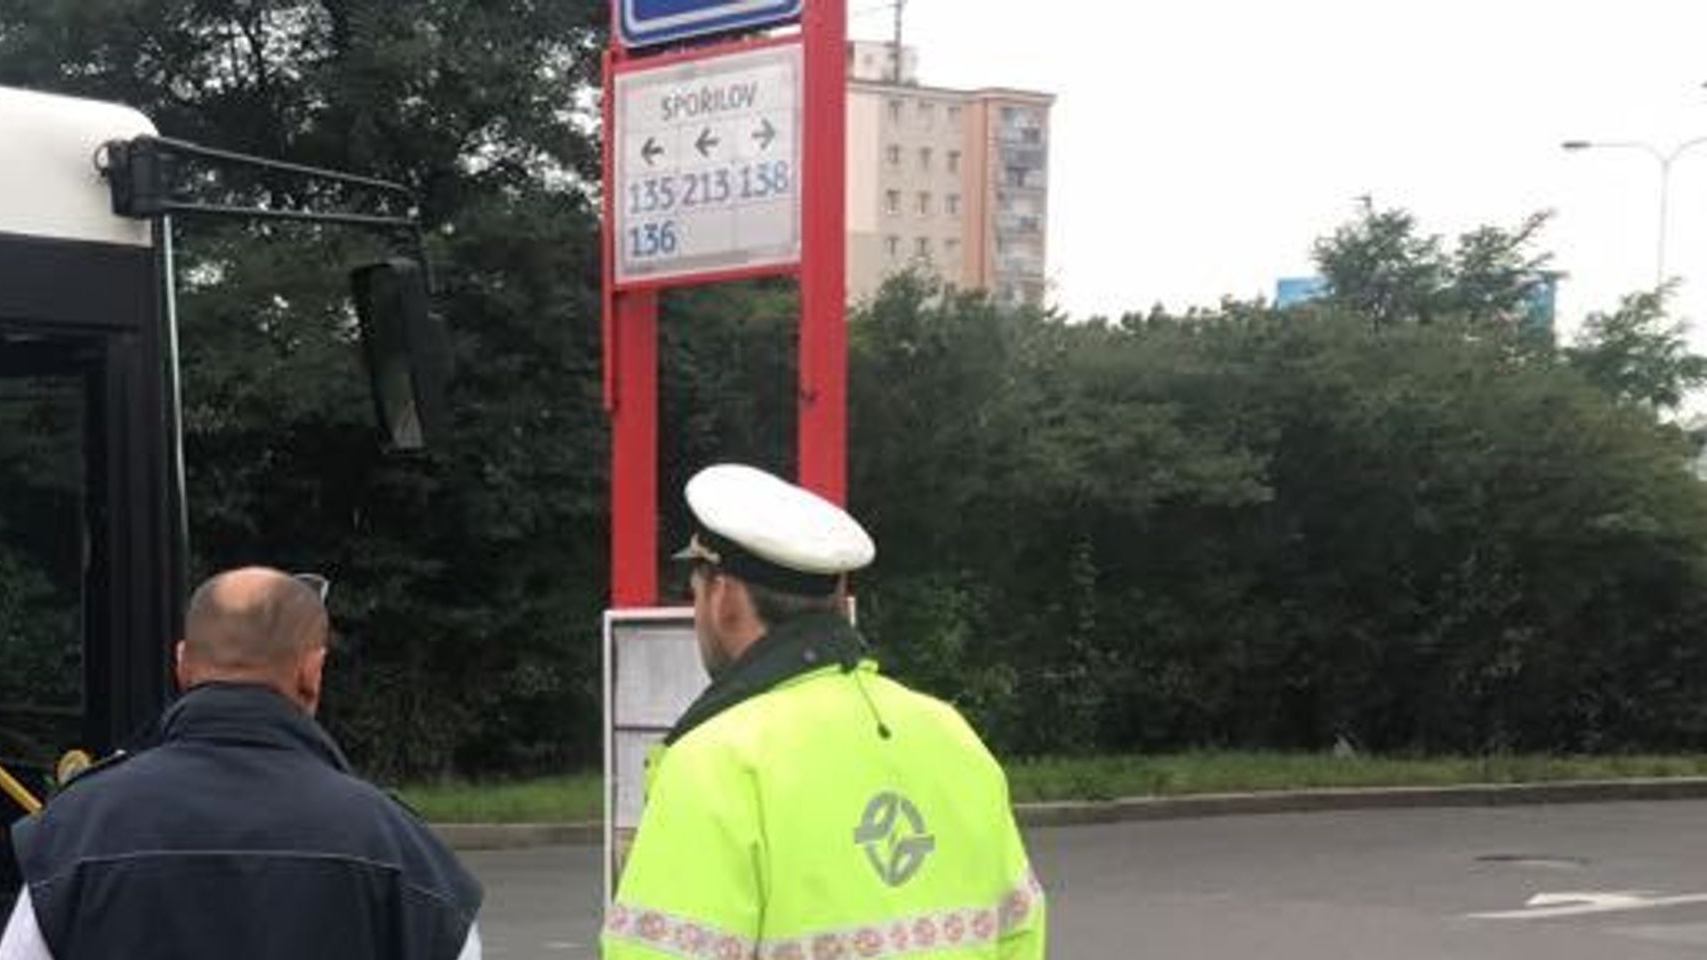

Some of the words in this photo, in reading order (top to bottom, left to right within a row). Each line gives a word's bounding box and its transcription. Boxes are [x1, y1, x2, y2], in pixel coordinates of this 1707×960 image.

[629, 177, 676, 214] 135
[680, 169, 730, 206] 213
[740, 160, 790, 199] 138
[629, 220, 677, 258] 136
